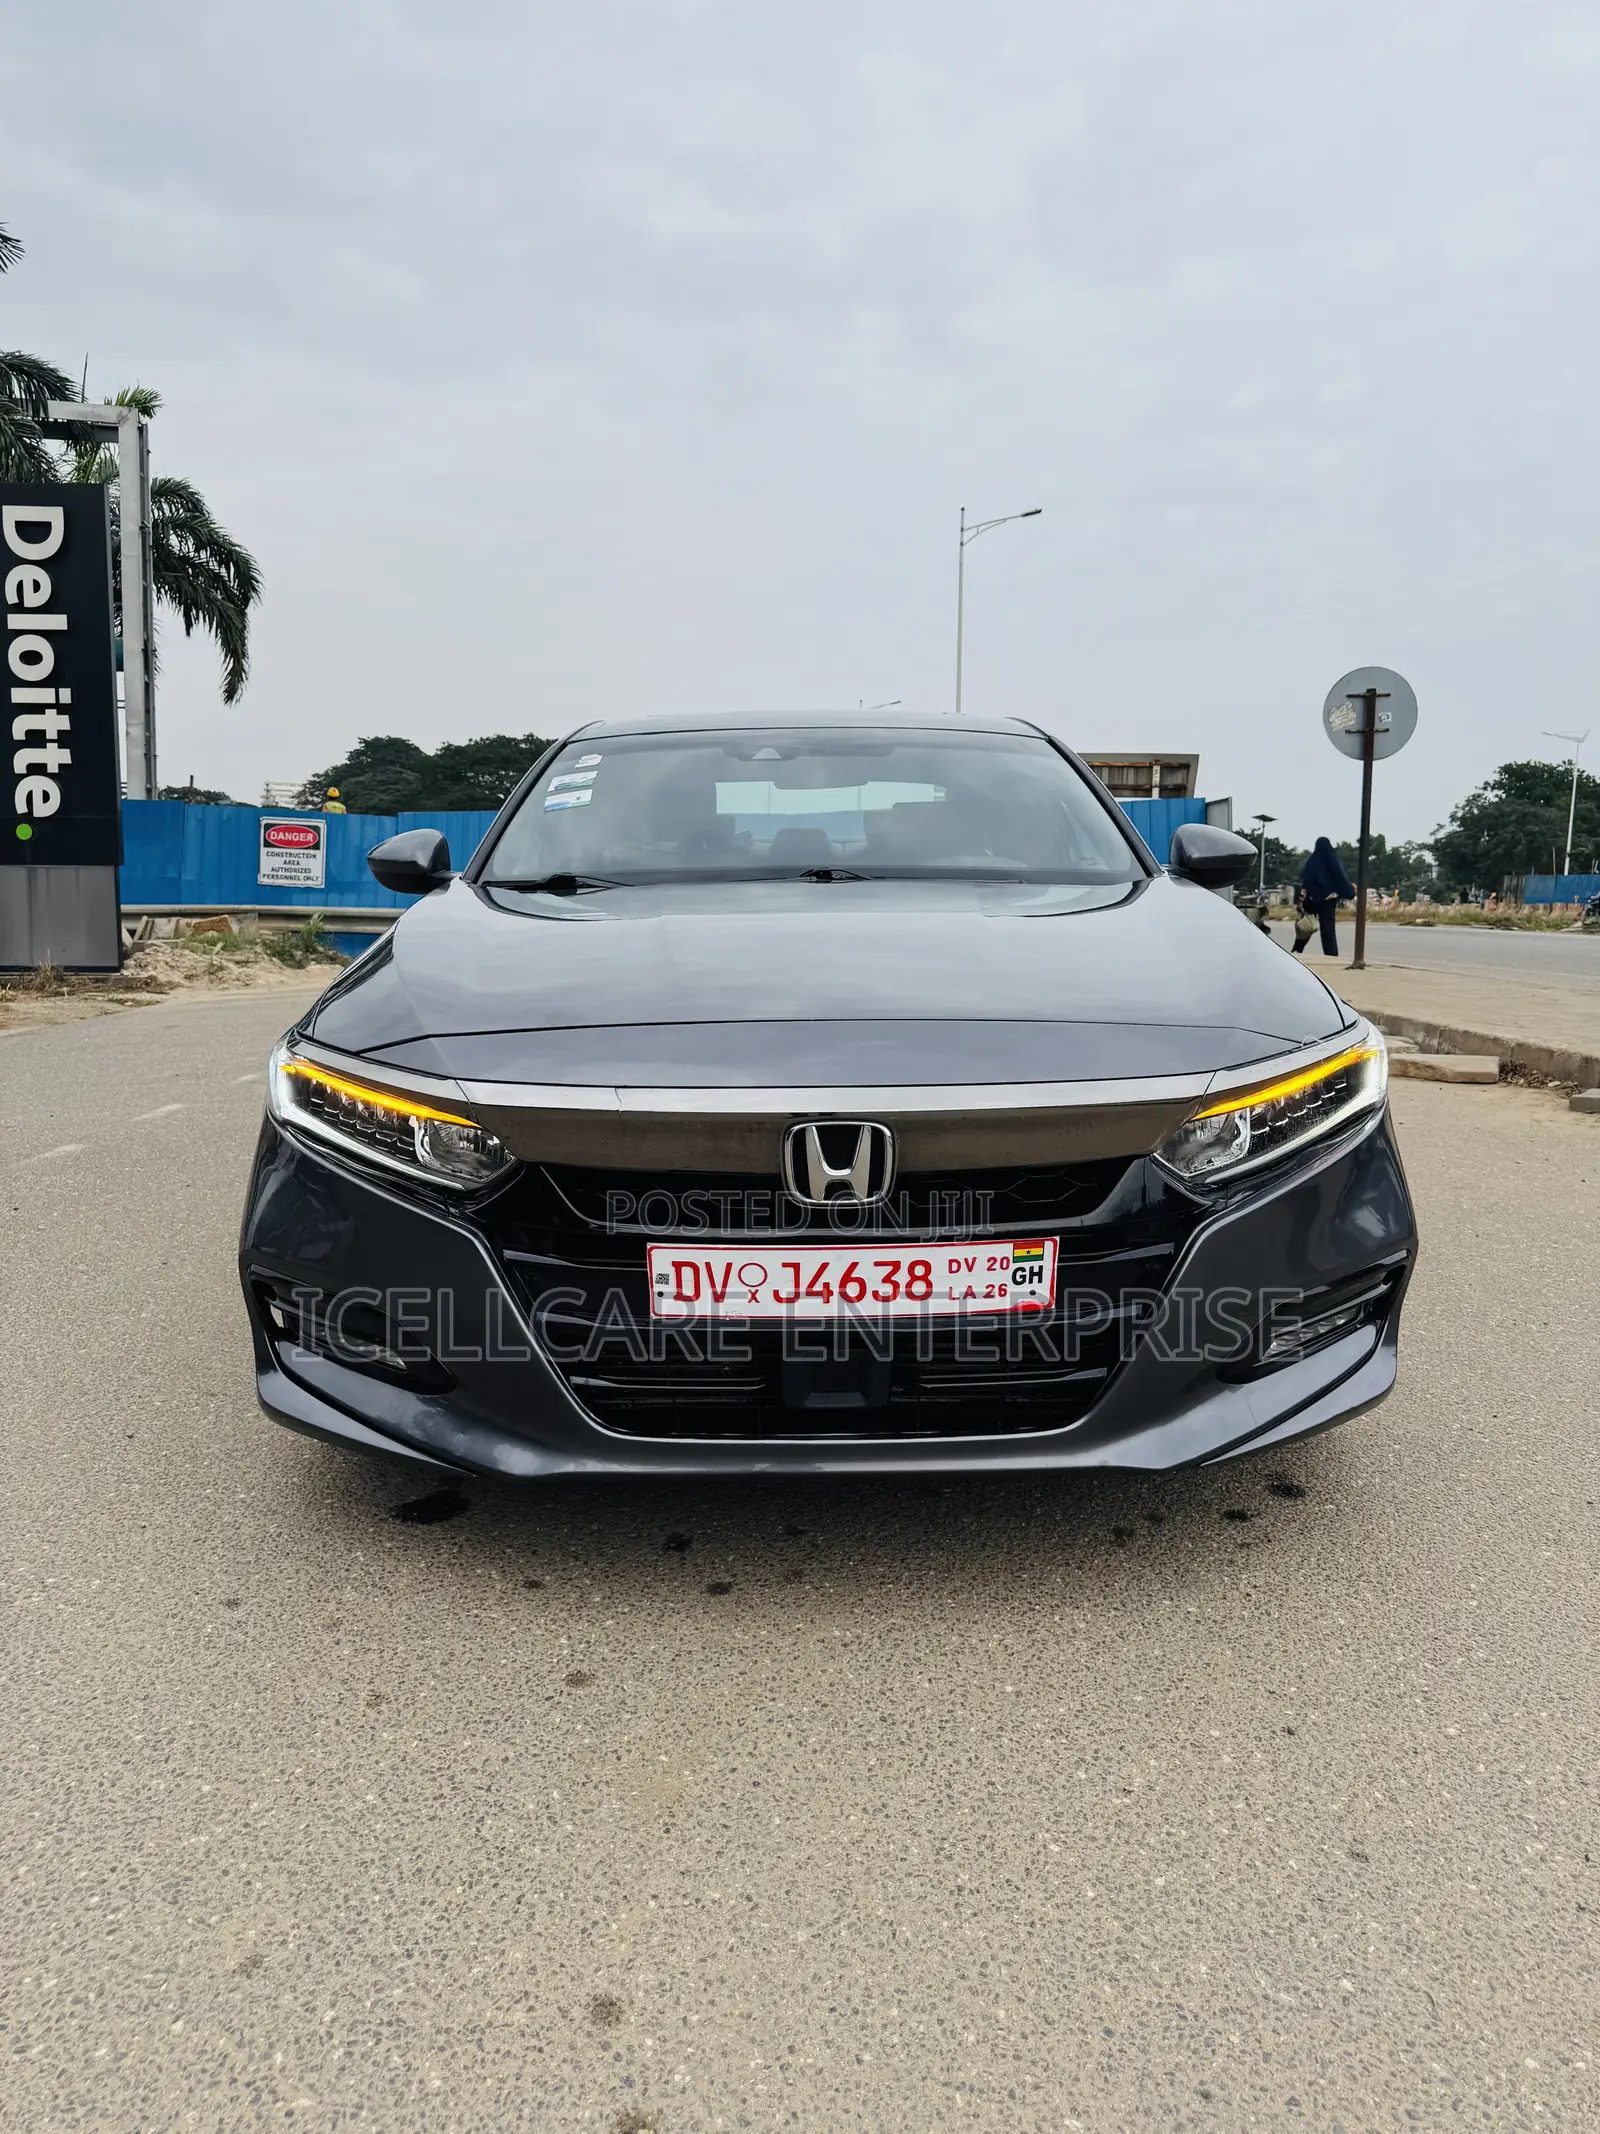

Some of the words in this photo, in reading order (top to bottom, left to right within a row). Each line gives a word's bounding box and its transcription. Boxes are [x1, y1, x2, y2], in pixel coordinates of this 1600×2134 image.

[270, 831, 314, 842] DANGER
[266, 851, 317, 859] CONSTRUCTION
[262, 873, 301, 881] PERSONNEL
[947, 1256, 977, 1274] DV
[986, 1255, 1011, 1272] 20
[671, 1261, 733, 1303] DV
[772, 1259, 934, 1304] J4638
[1011, 1264, 1044, 1286] GH
[948, 1284, 977, 1301] LA
[982, 1282, 1009, 1299] 26
